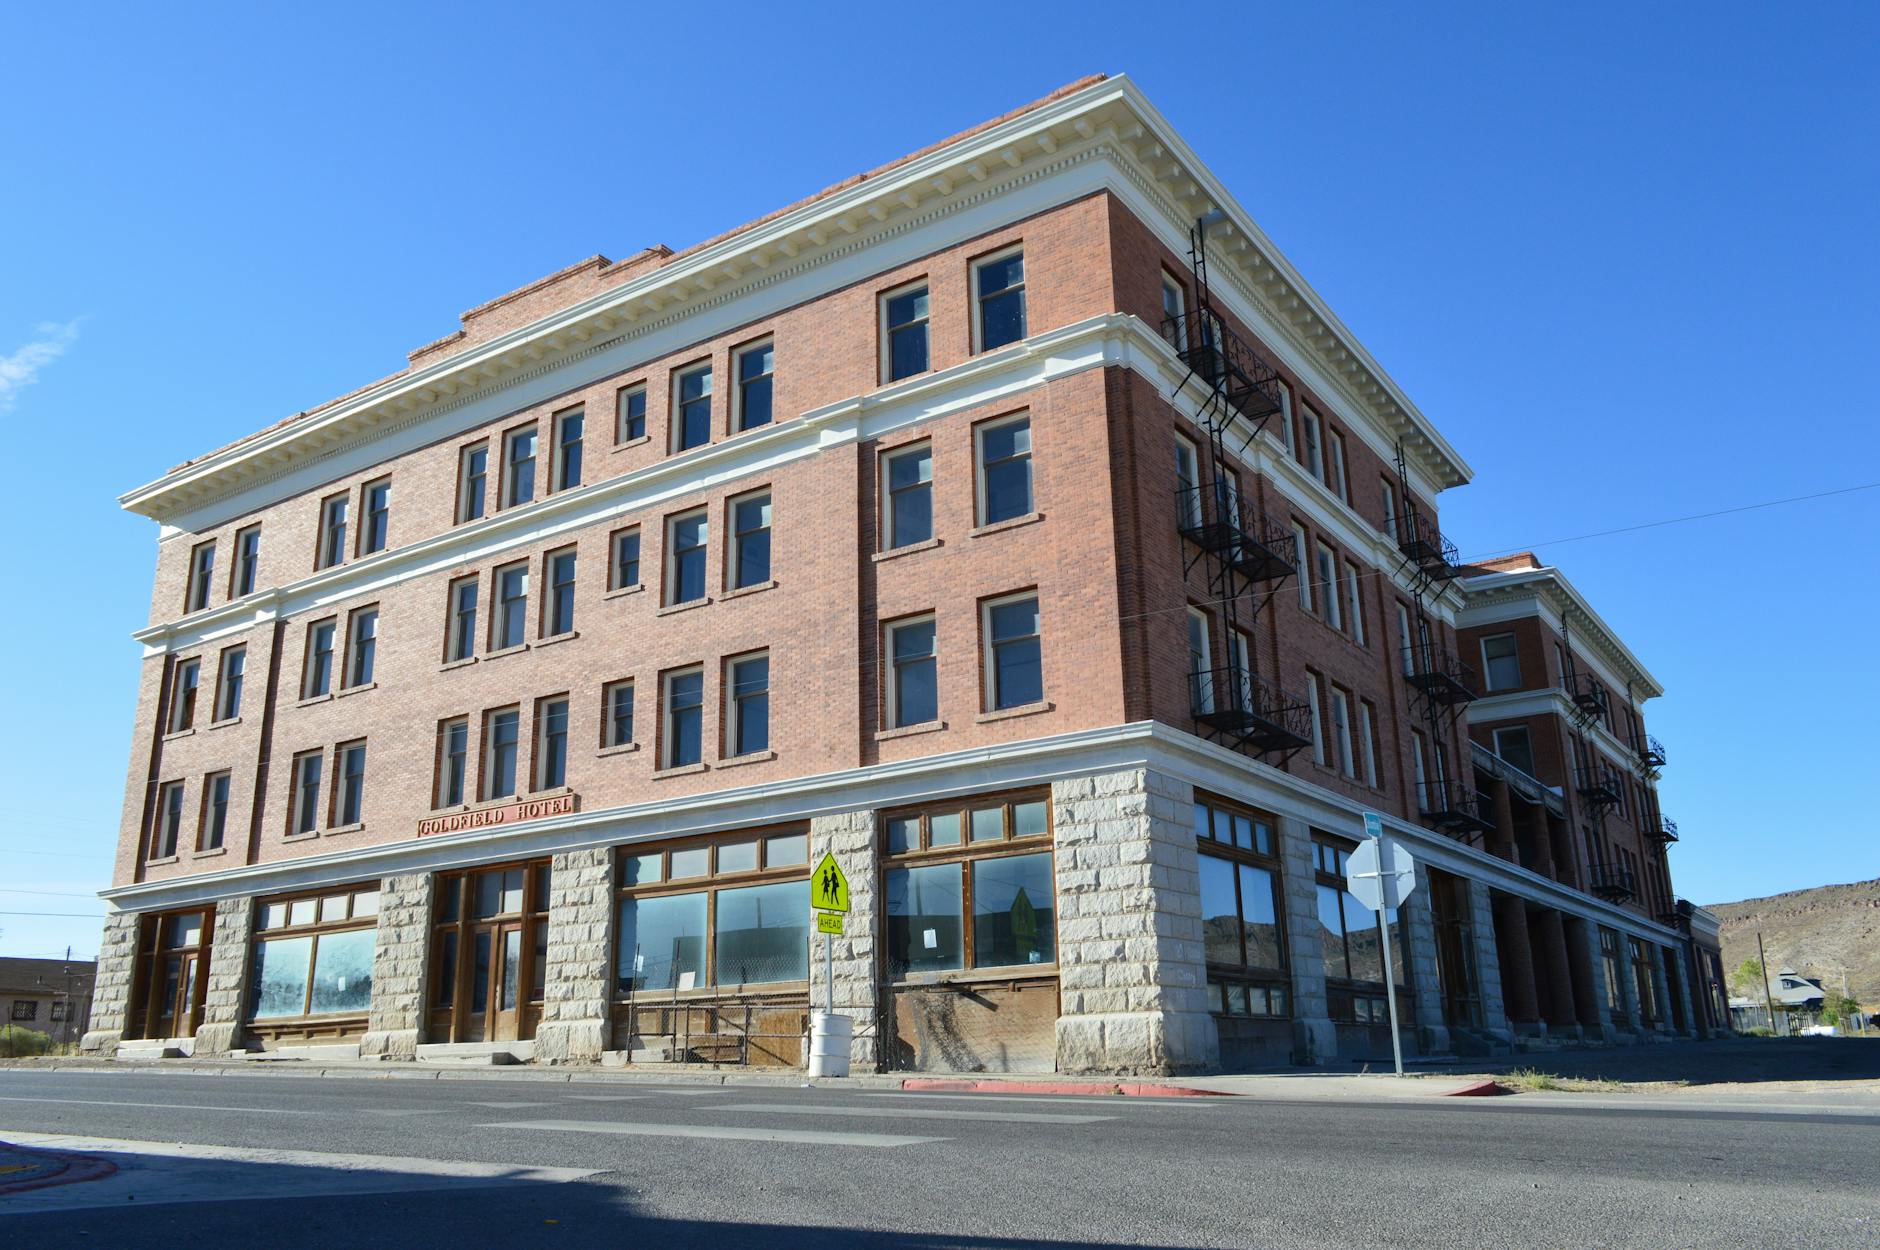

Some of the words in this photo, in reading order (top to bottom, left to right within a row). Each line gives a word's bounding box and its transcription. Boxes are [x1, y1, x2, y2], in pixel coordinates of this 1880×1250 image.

[420, 808, 504, 835] GOLDFIELD
[516, 798, 572, 820] HOTEL
[819, 918, 841, 930] AHEAD
